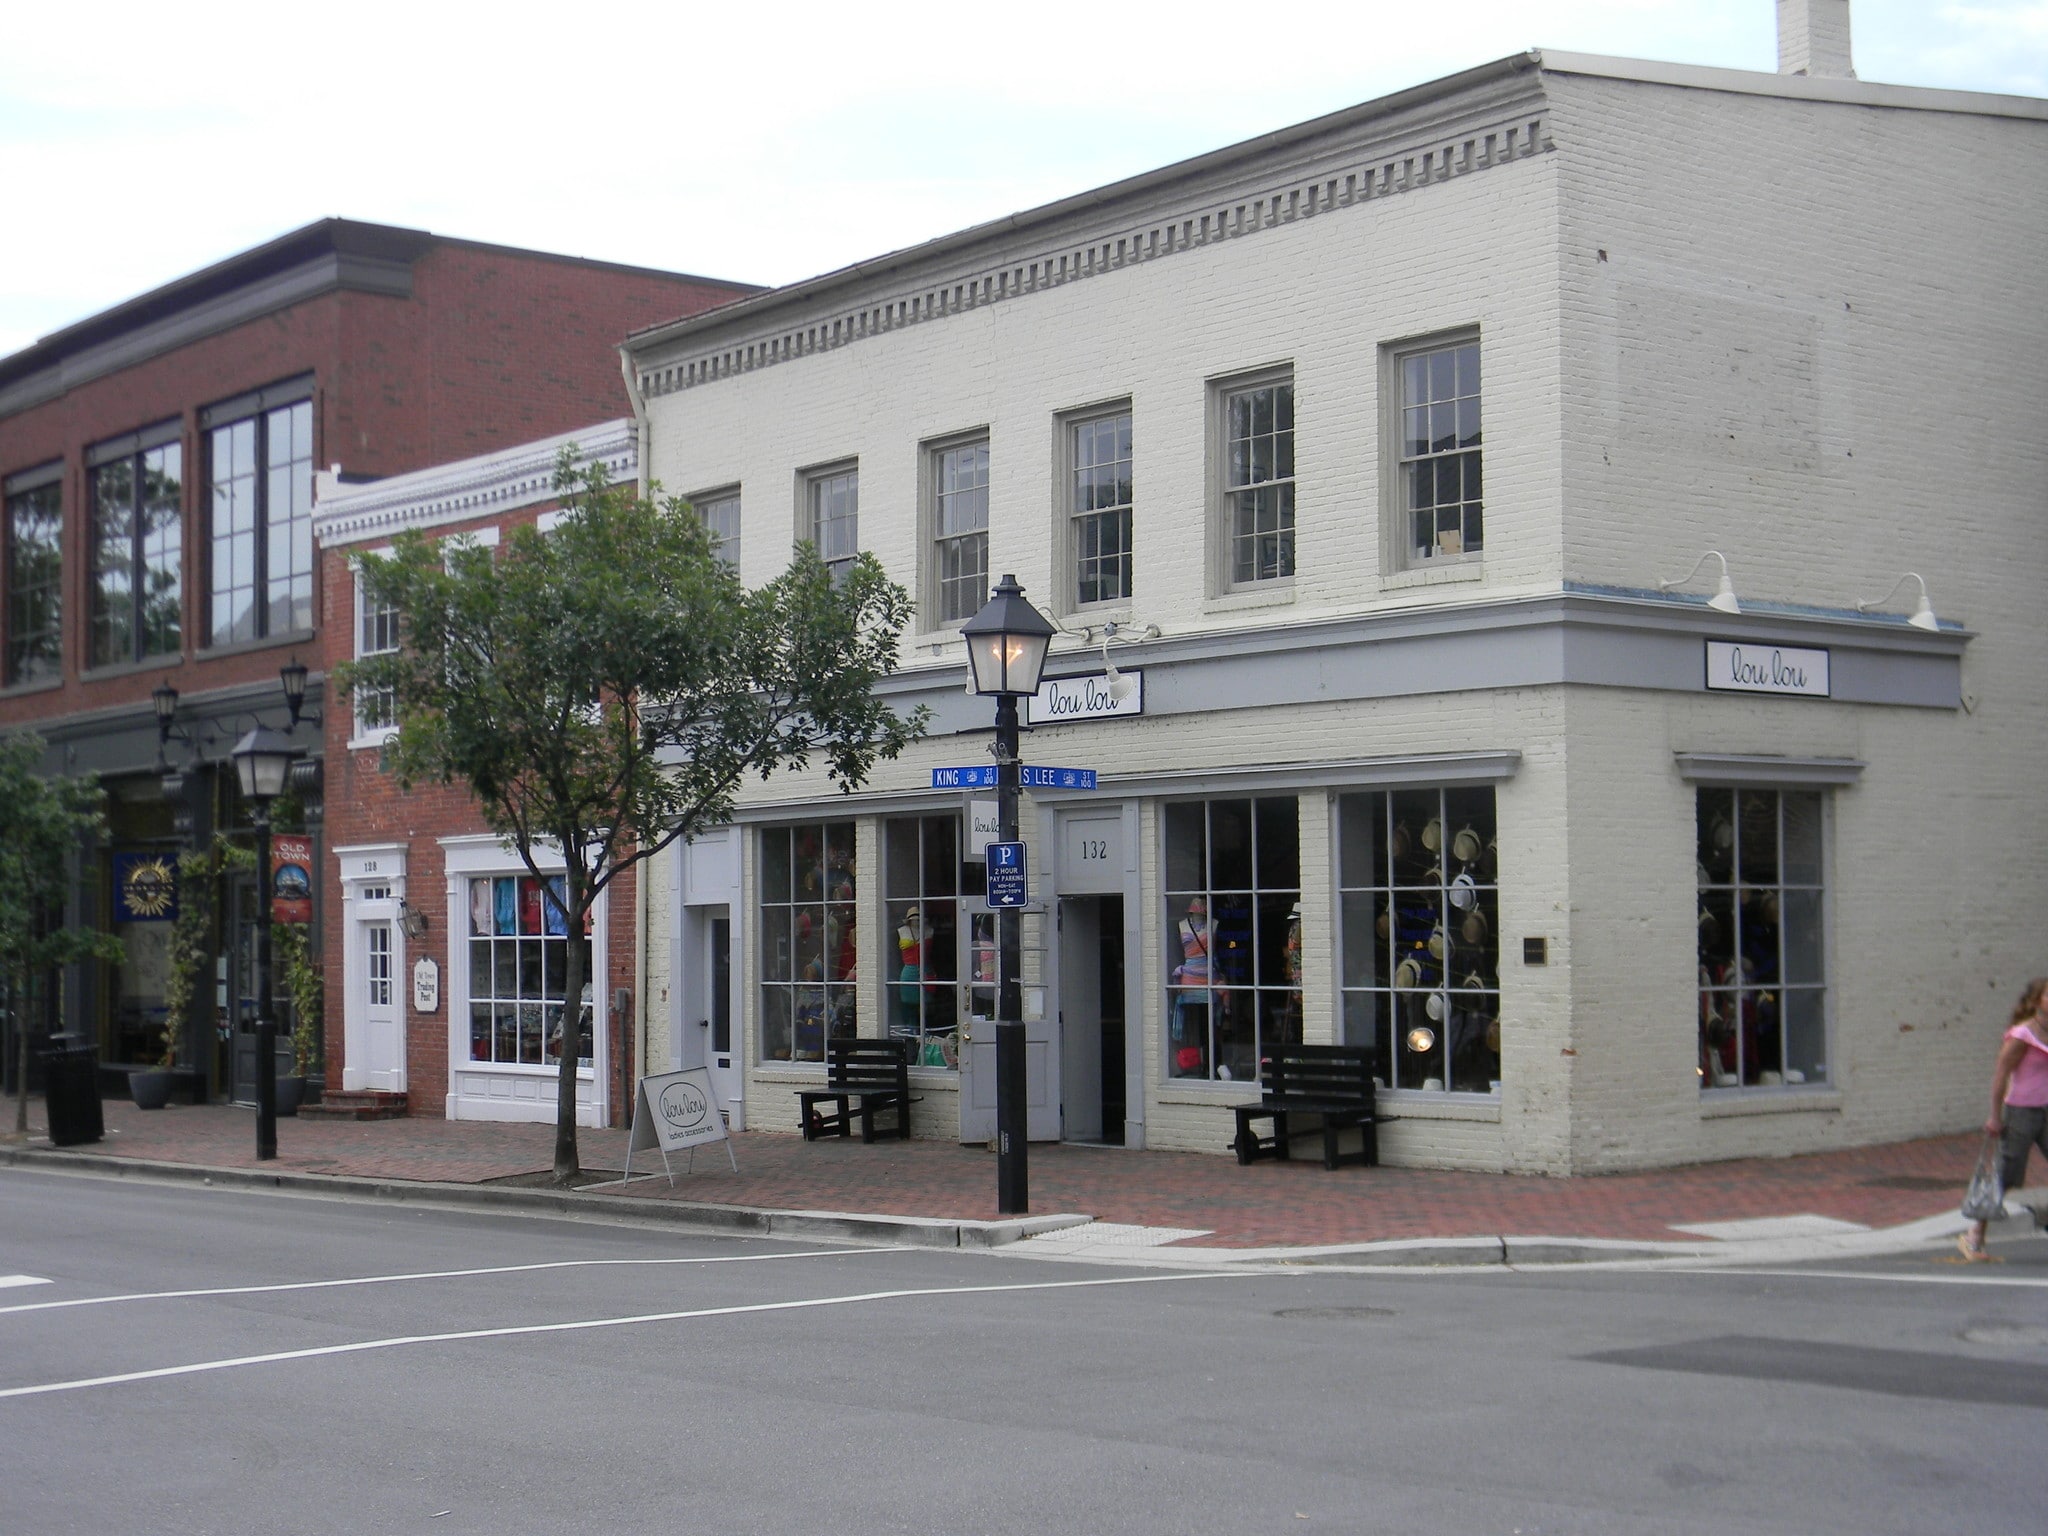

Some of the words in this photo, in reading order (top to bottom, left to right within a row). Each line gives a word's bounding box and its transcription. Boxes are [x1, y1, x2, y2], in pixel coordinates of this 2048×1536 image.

[1732, 647, 1768, 684] lou
[1772, 650, 1807, 687] lou
[1049, 683, 1082, 714] lou
[936, 770, 959, 786] KING
[984, 776, 993, 784] 100
[1023, 769, 1030, 784] S
[1035, 770, 1055, 785] LEE
[1083, 771, 1091, 779] ST
[1080, 780, 1092, 788] 100
[274, 851, 310, 861] TOWN
[280, 843, 305, 853] OLD
[1000, 847, 1011, 865] P
[1083, 840, 1107, 860] 132
[364, 861, 377, 872] 128
[664, 1098, 684, 1118] lou
[683, 1094, 704, 1113] lou
